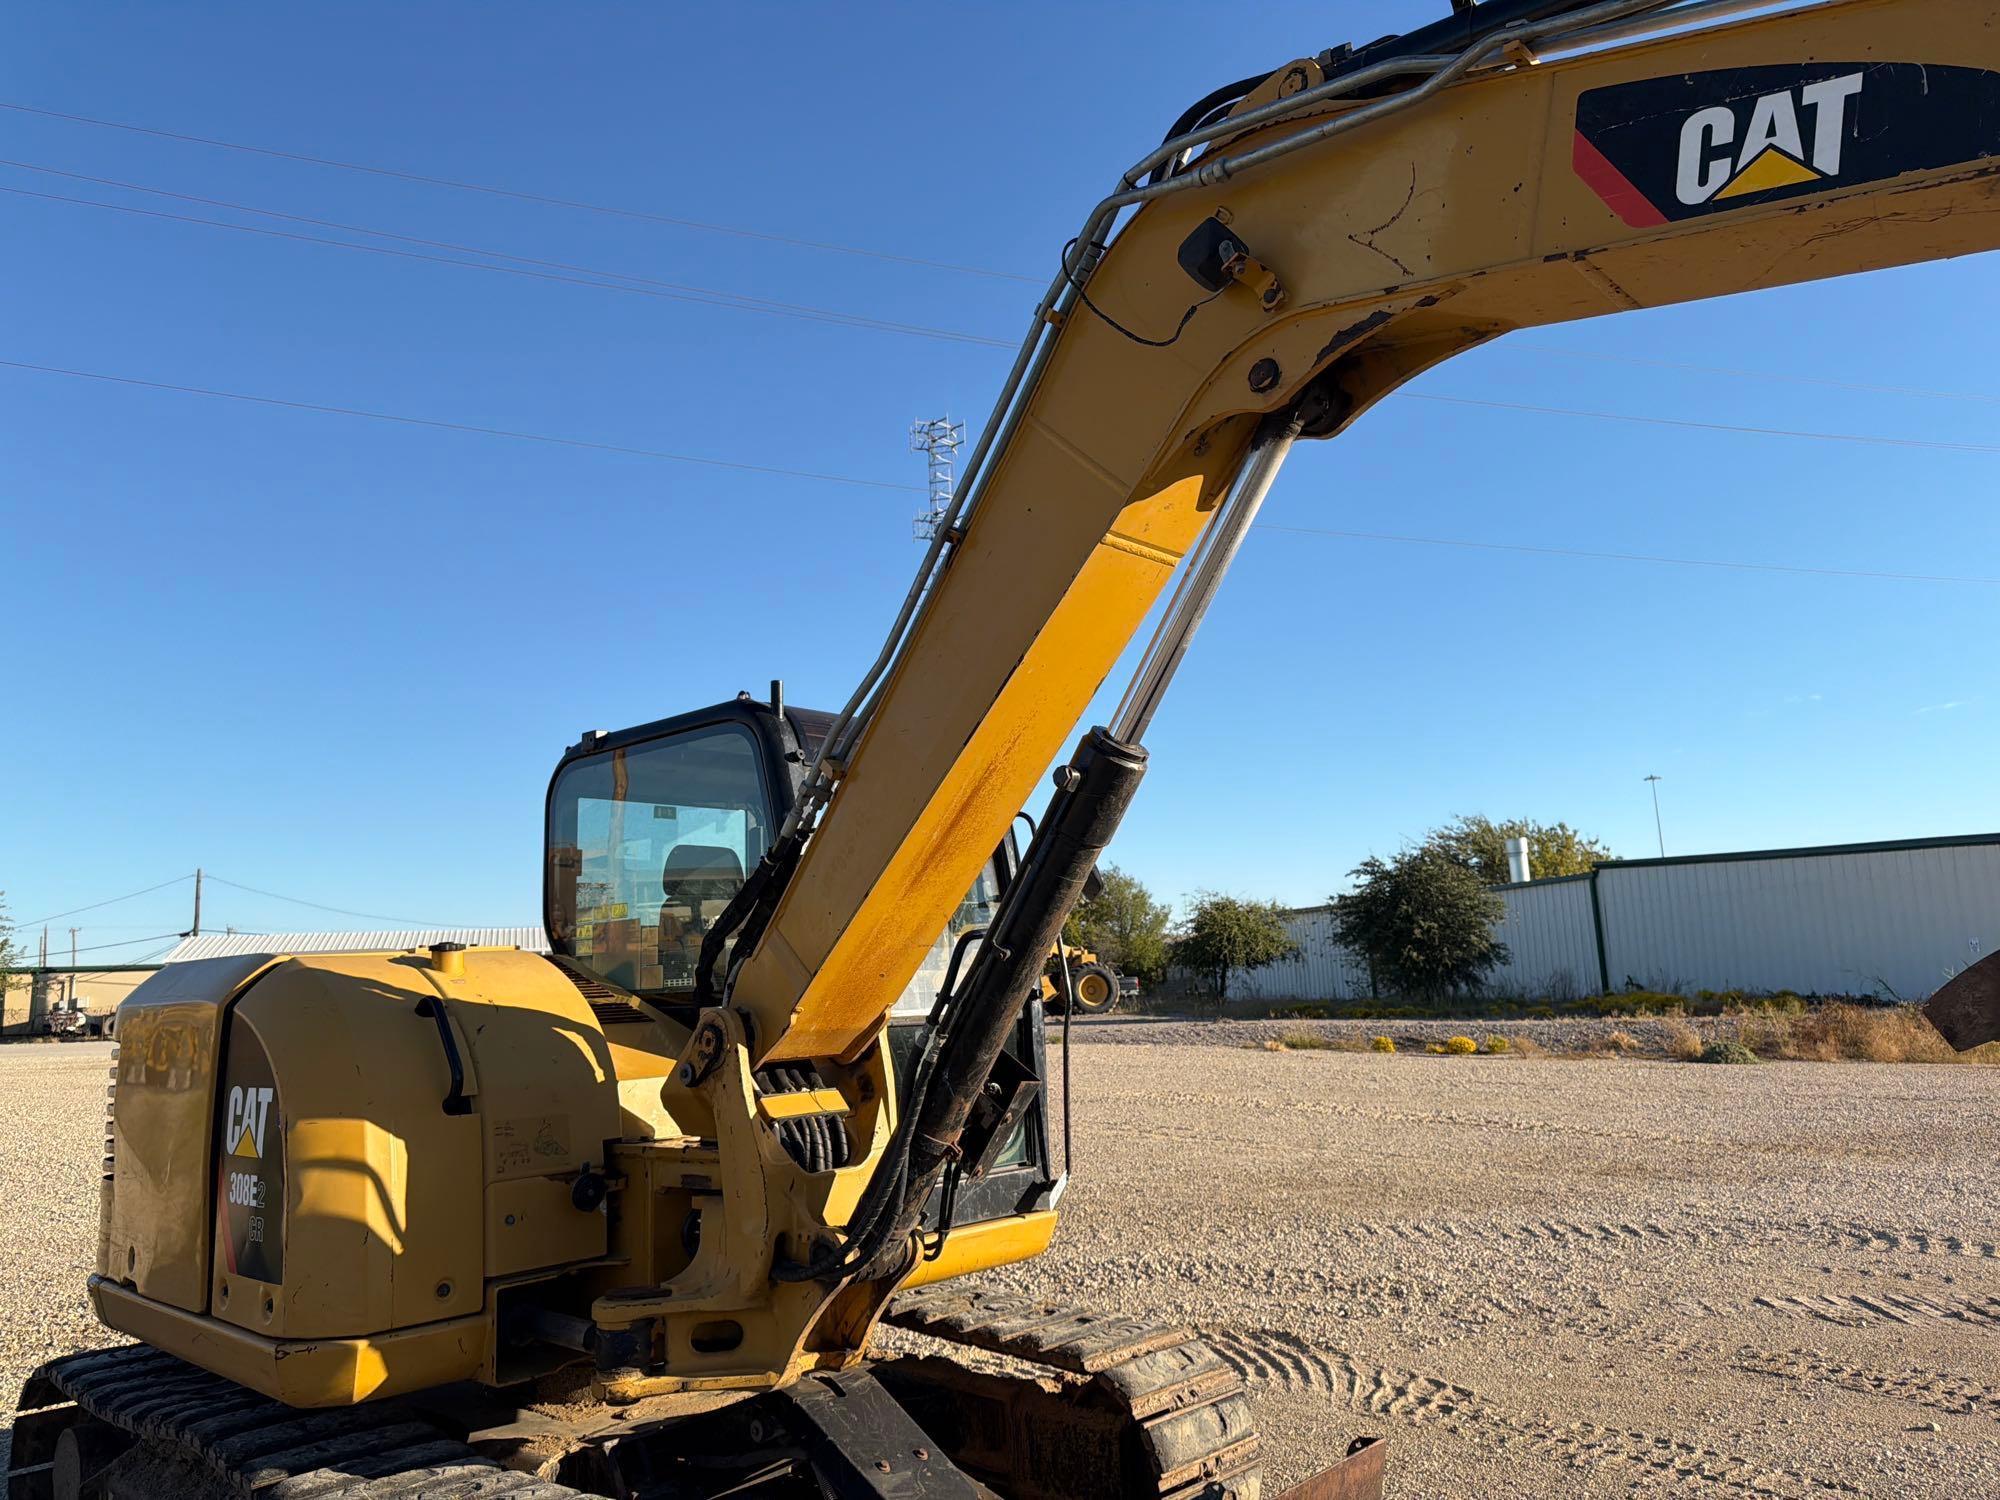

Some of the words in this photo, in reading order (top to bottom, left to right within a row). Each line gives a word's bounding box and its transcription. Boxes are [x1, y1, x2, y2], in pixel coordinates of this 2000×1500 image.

[1676, 72, 1863, 205] CAT
[226, 1086, 273, 1159] CAT
[248, 1215, 265, 1243] CR
